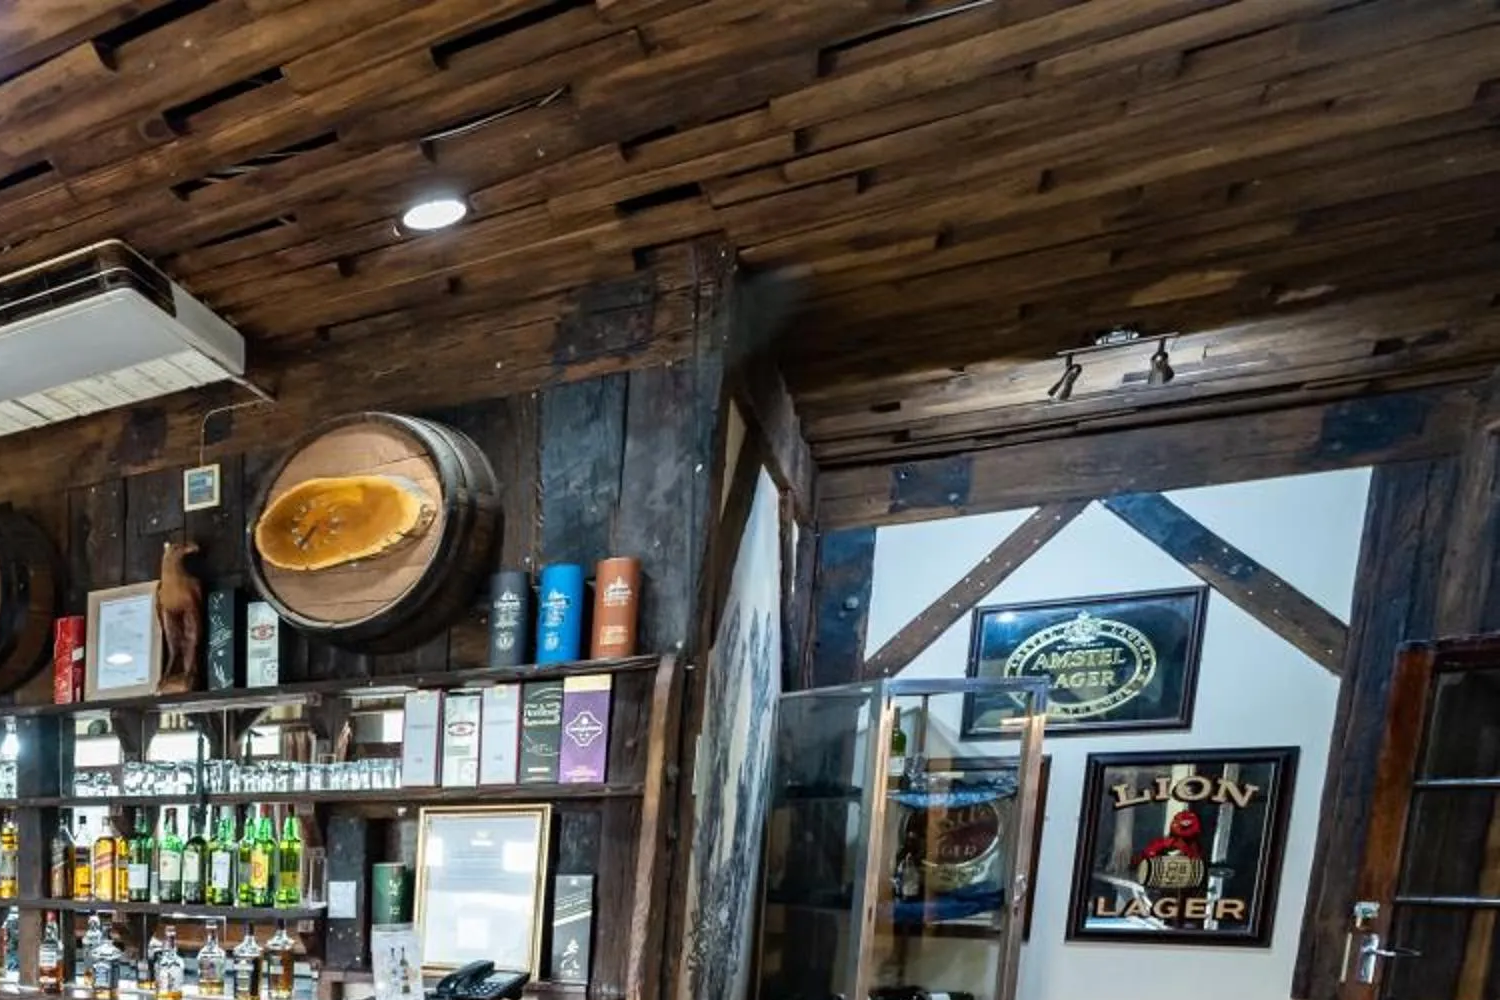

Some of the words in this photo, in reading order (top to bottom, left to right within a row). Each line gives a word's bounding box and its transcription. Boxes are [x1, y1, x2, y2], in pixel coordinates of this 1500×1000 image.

[1030, 647, 1127, 671] AMSTEL
[1049, 670, 1117, 689] AGER
[1111, 775, 1260, 809] LION
[1095, 896, 1246, 920] LAGER
